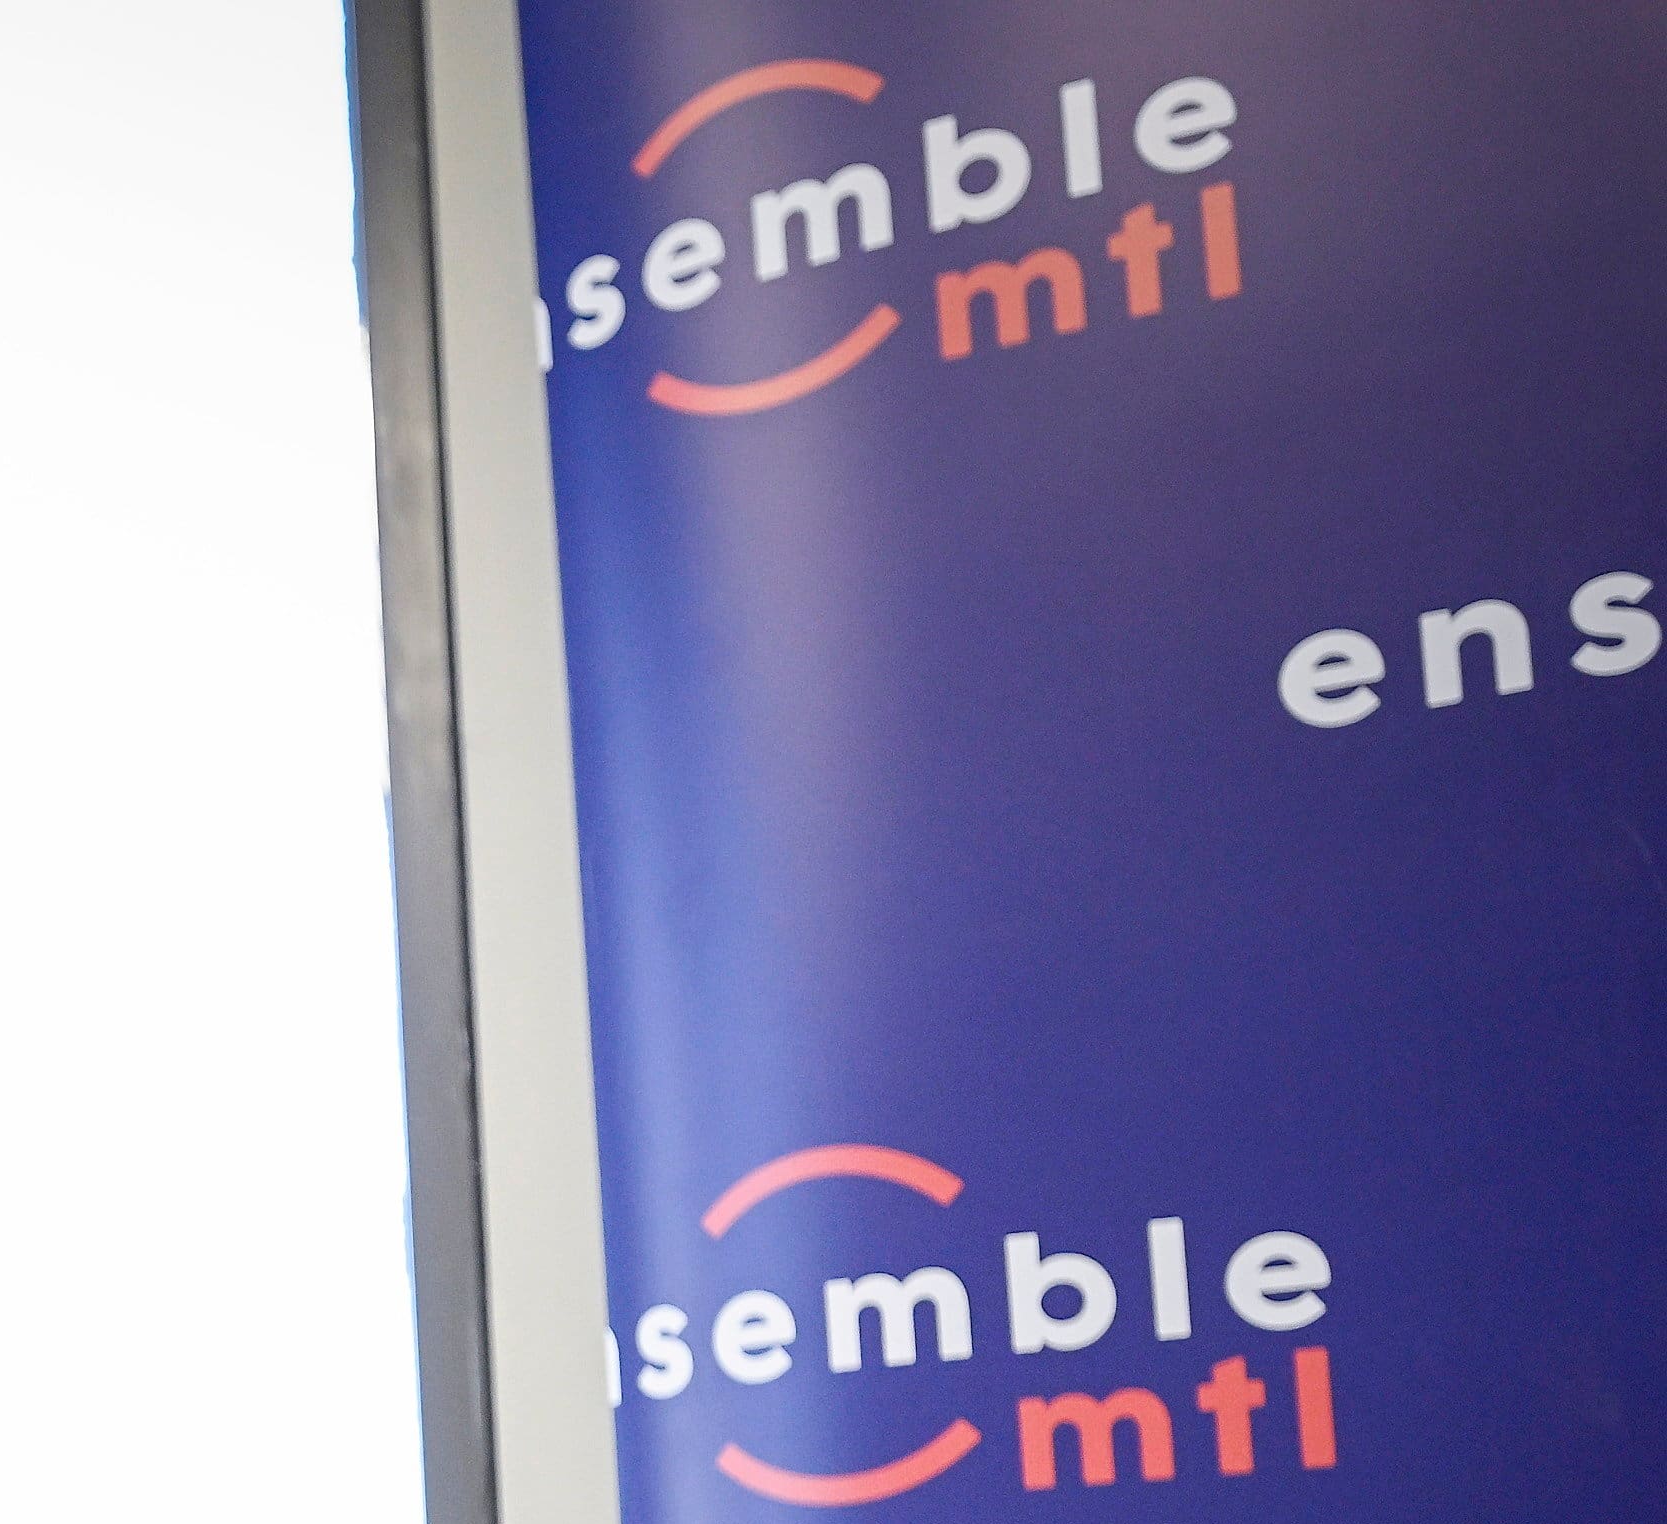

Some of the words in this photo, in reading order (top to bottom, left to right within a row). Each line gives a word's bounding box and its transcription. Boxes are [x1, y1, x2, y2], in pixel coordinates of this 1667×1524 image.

[934, 182, 1244, 361] mtl
[1277, 571, 1663, 729] ens
[1017, 1346, 1337, 1491] mtl
